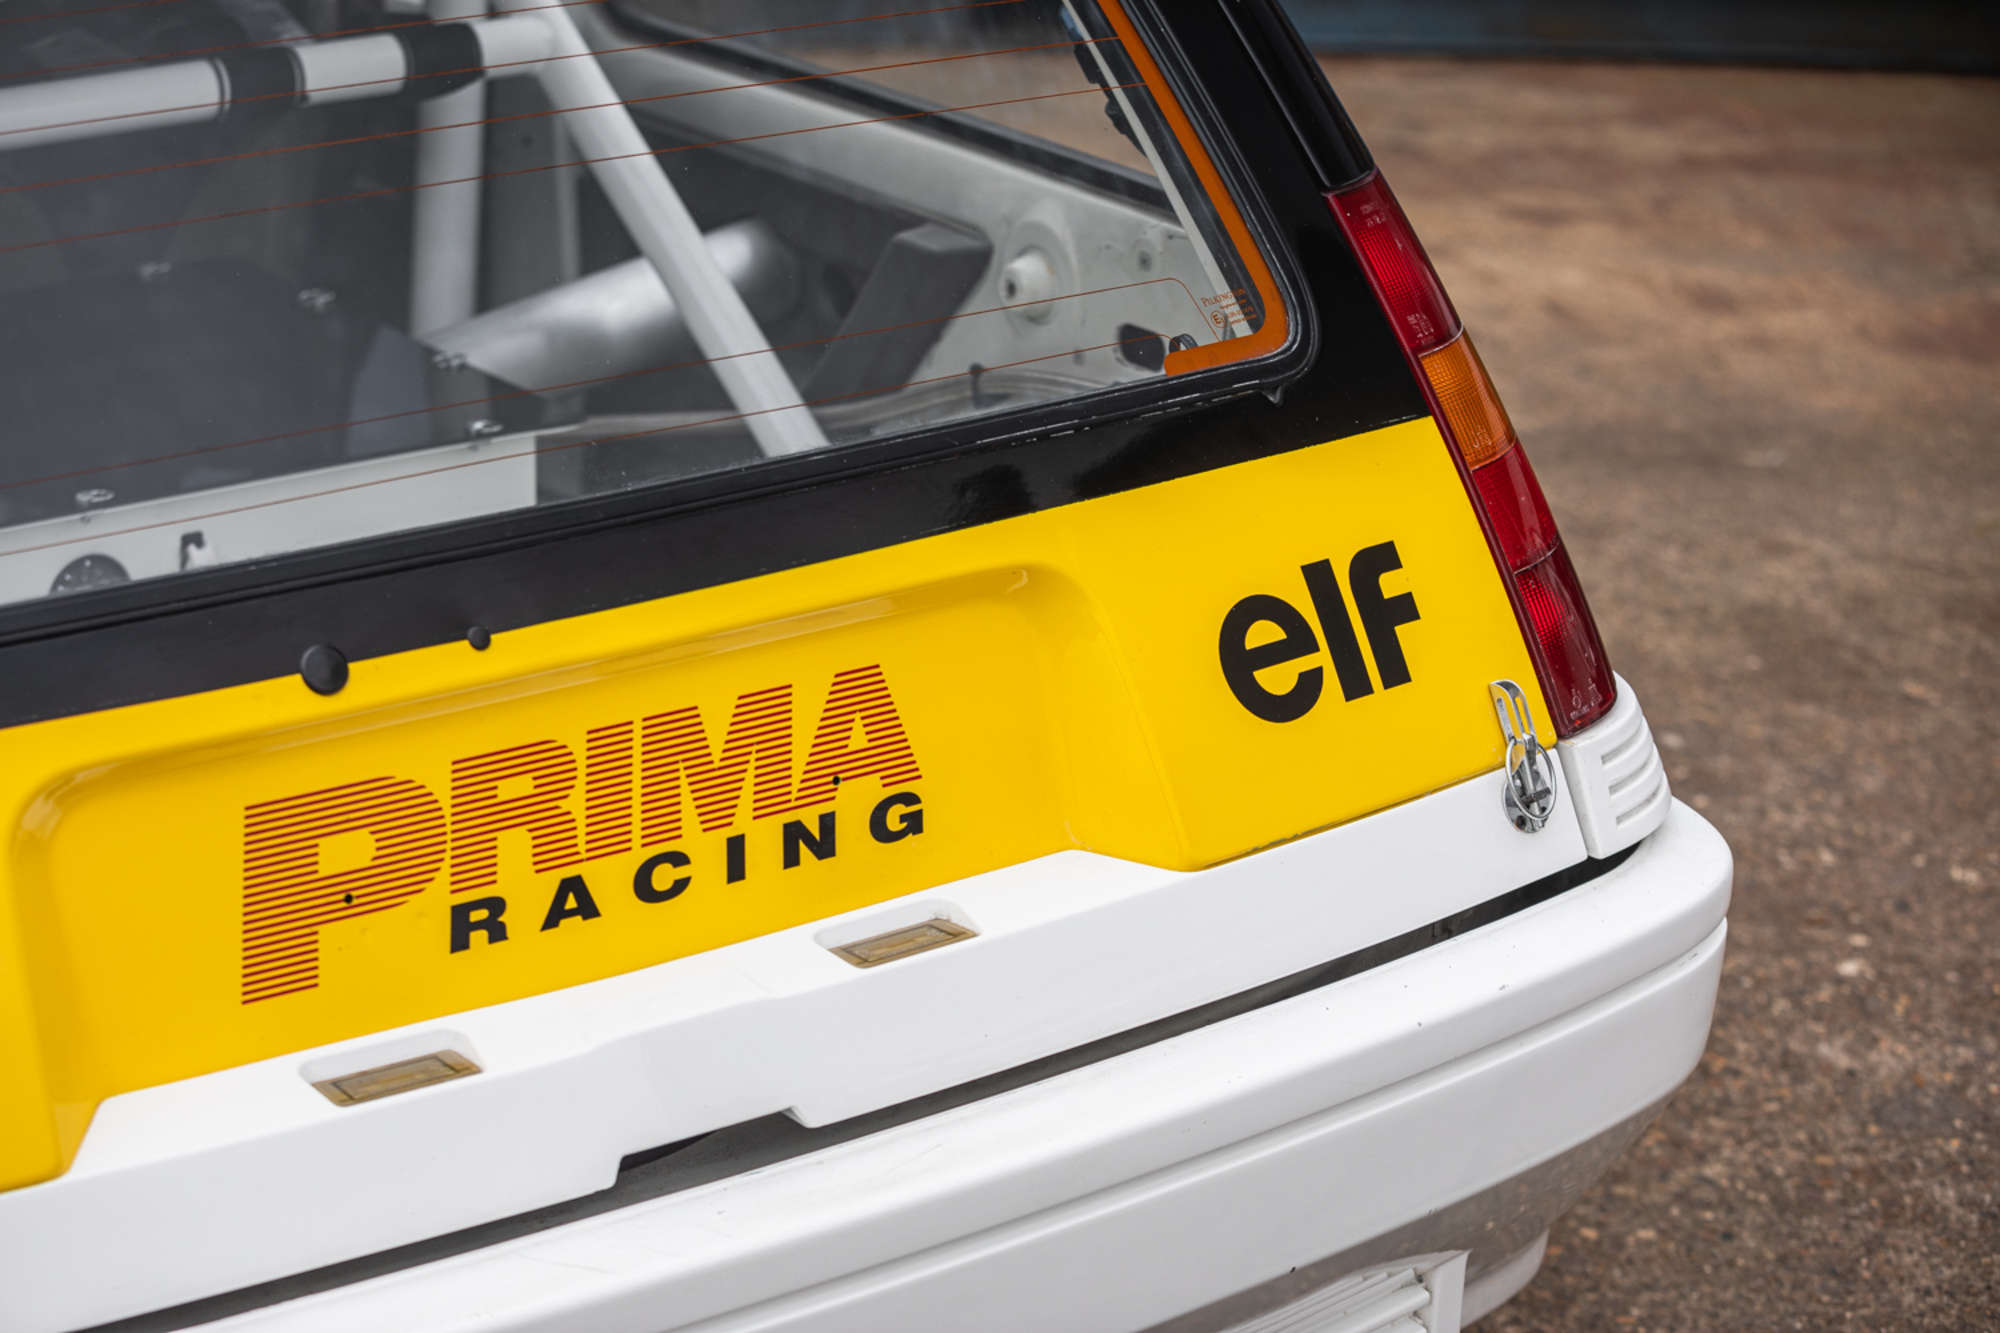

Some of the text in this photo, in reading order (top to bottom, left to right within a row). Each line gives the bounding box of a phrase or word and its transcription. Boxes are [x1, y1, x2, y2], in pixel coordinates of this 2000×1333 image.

[1219, 540, 1421, 723] elf
[242, 664, 923, 1005] PRIMA
[450, 791, 924, 953] RACING
